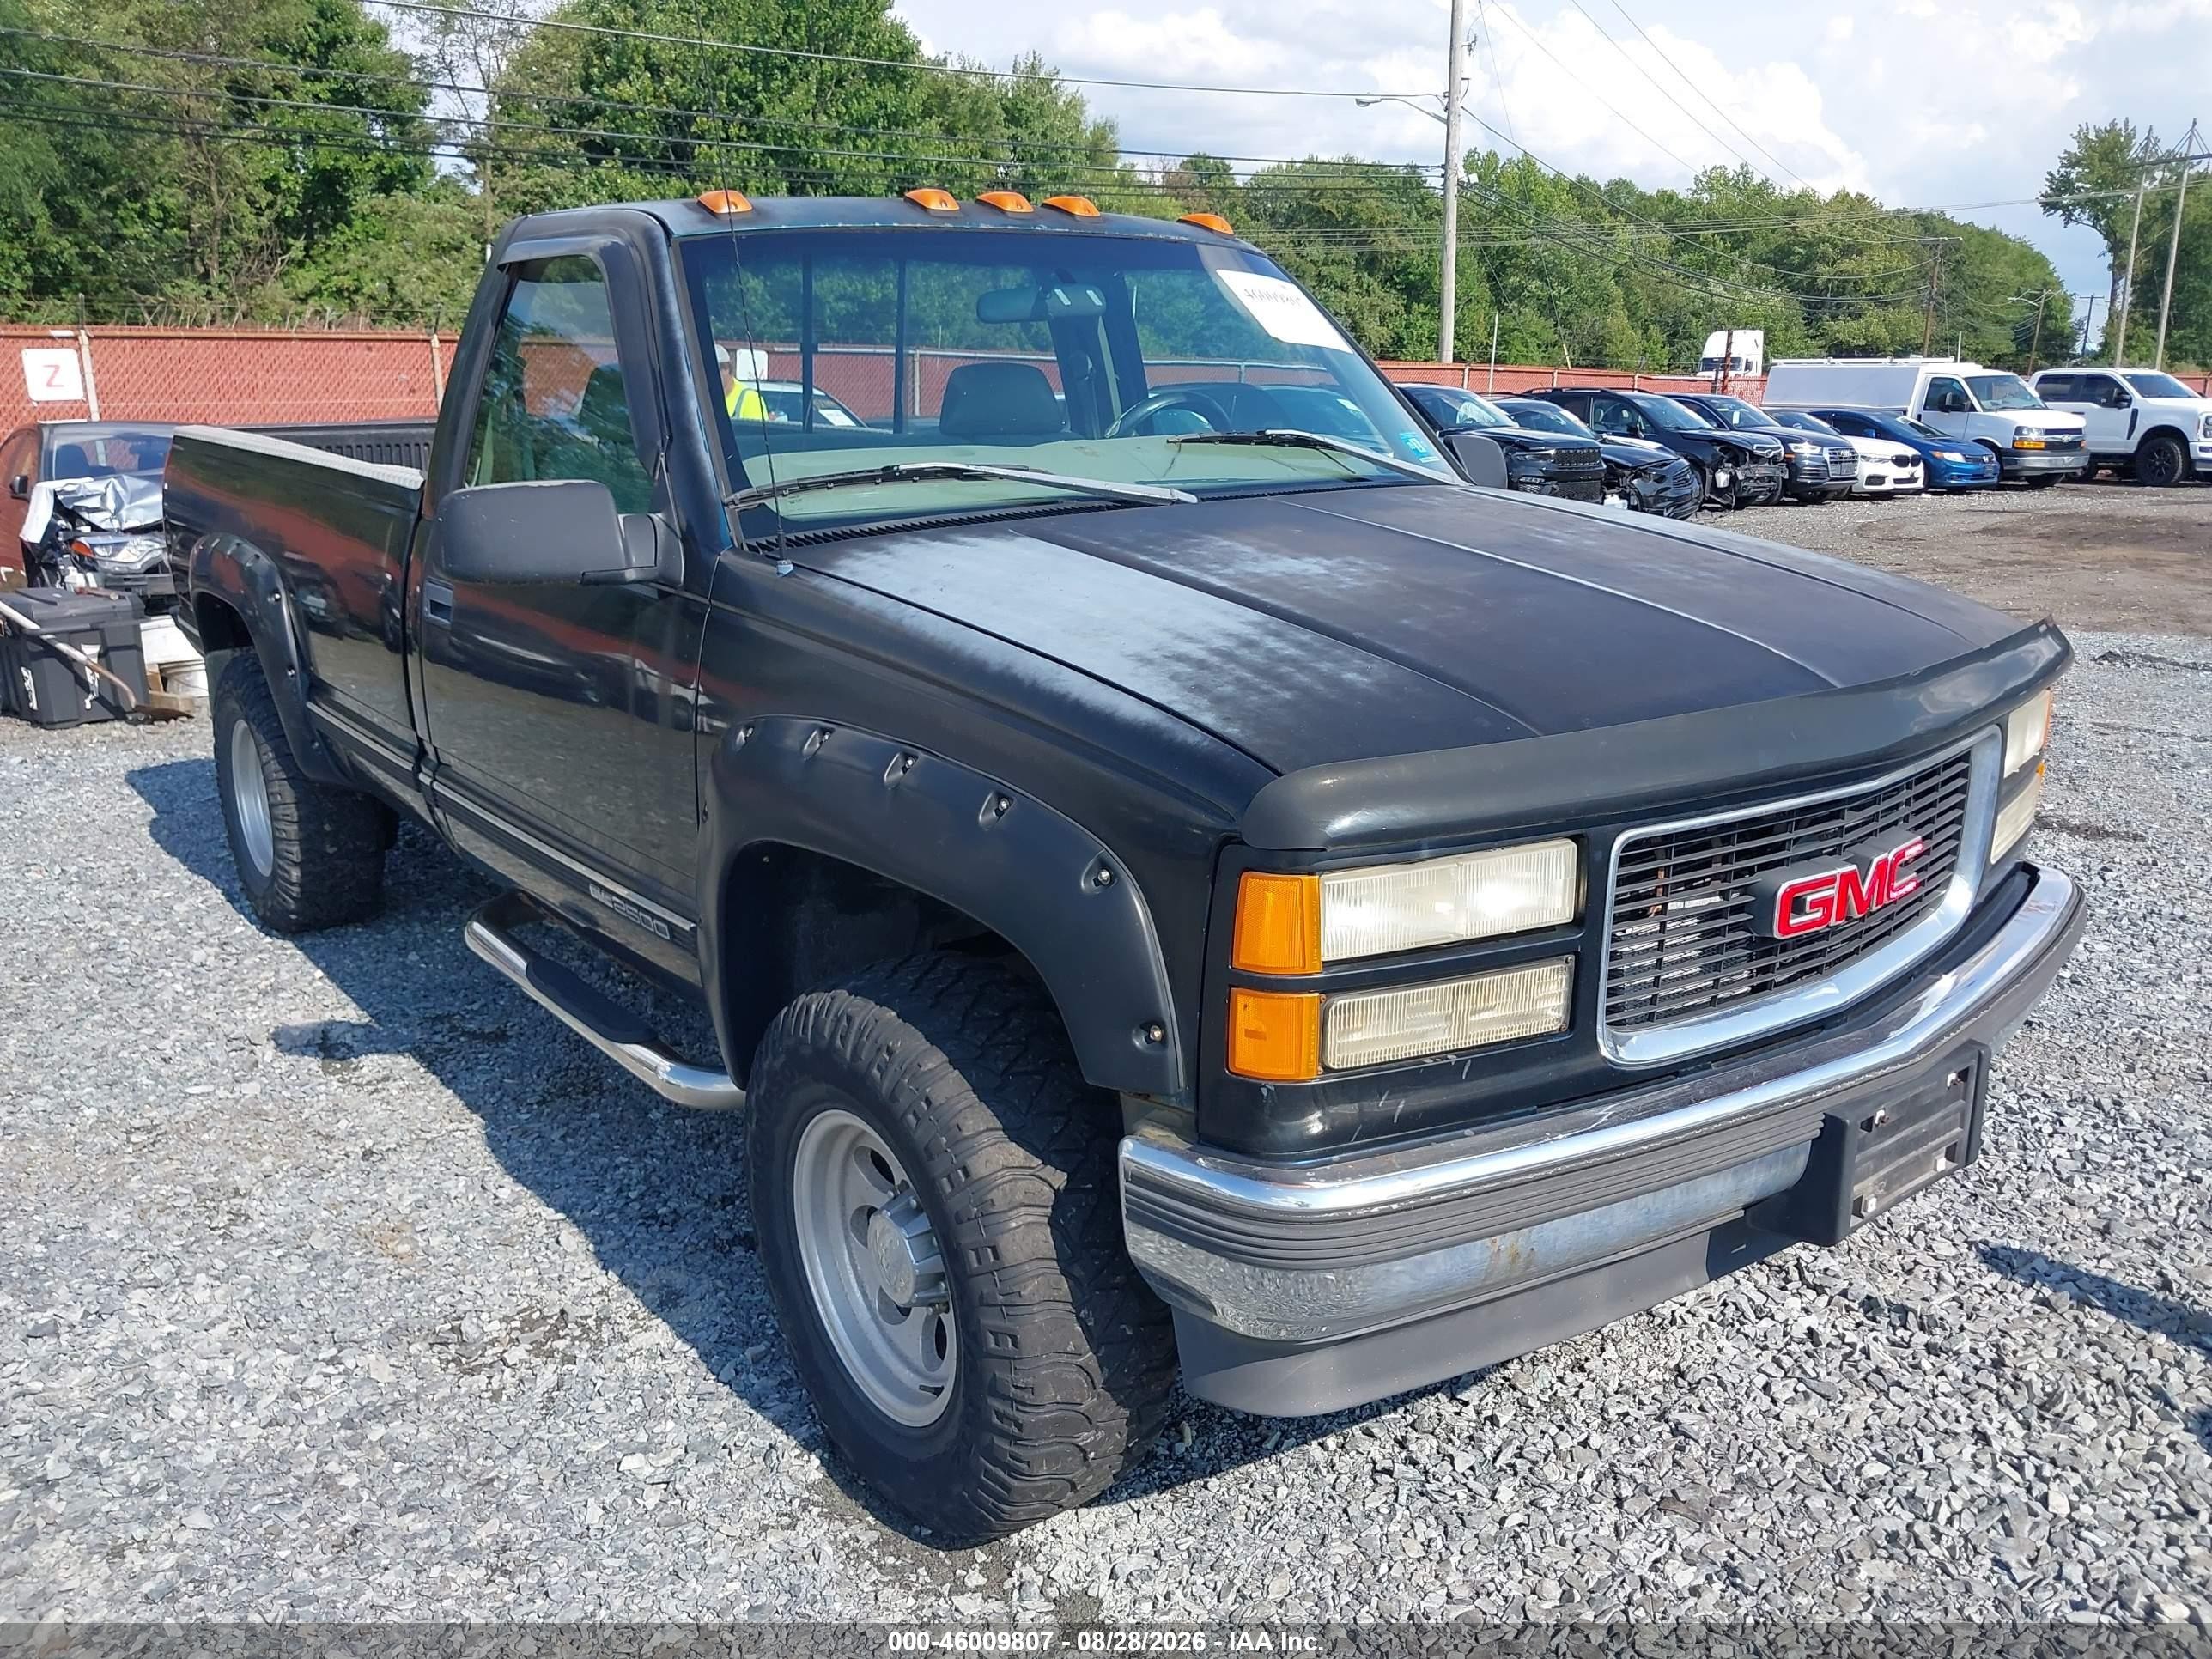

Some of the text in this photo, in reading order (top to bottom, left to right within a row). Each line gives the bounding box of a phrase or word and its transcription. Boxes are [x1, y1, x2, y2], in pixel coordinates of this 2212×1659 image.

[42, 364, 65, 388] Z
[1773, 836, 1923, 939] GMC
[612, 896, 670, 939] 2500
